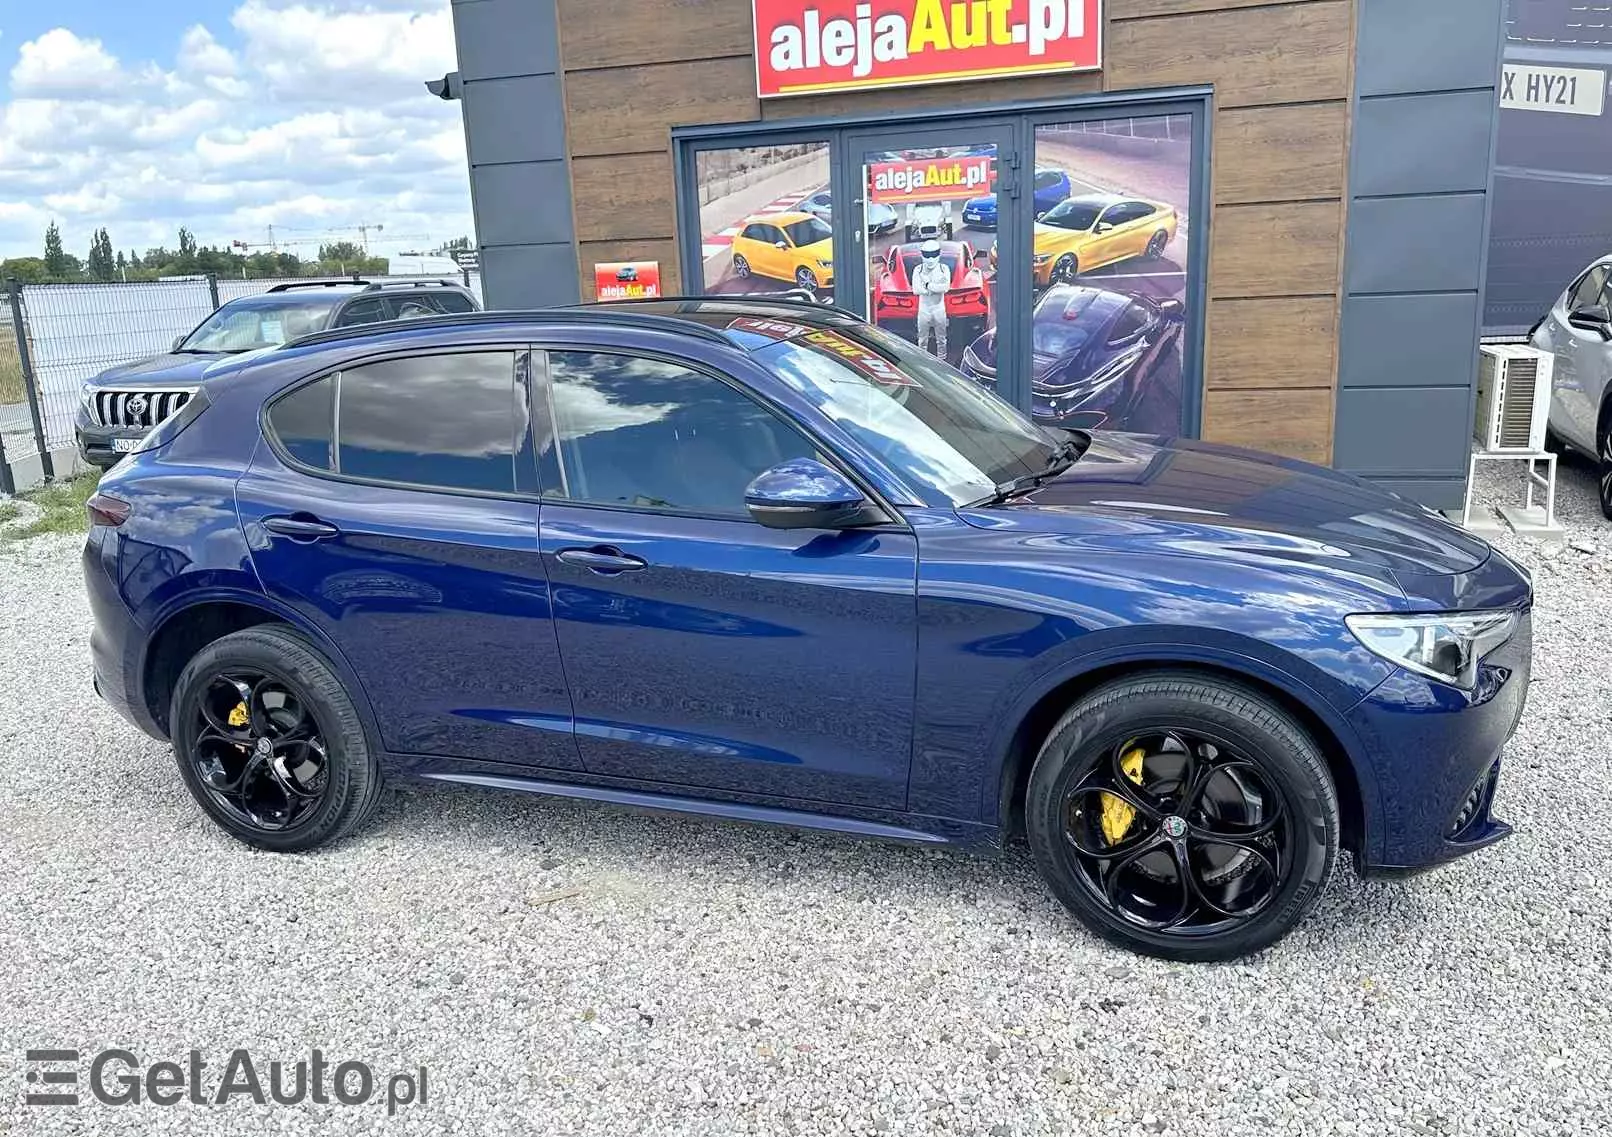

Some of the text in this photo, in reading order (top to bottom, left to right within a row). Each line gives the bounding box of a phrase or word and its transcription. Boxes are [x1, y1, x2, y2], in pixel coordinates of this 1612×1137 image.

[770, 0, 1085, 77] alejaAut.pl
[1502, 71, 1577, 105] X HY21
[875, 161, 987, 193] alejaAut.pl
[601, 284, 657, 297] alejaAut.pl
